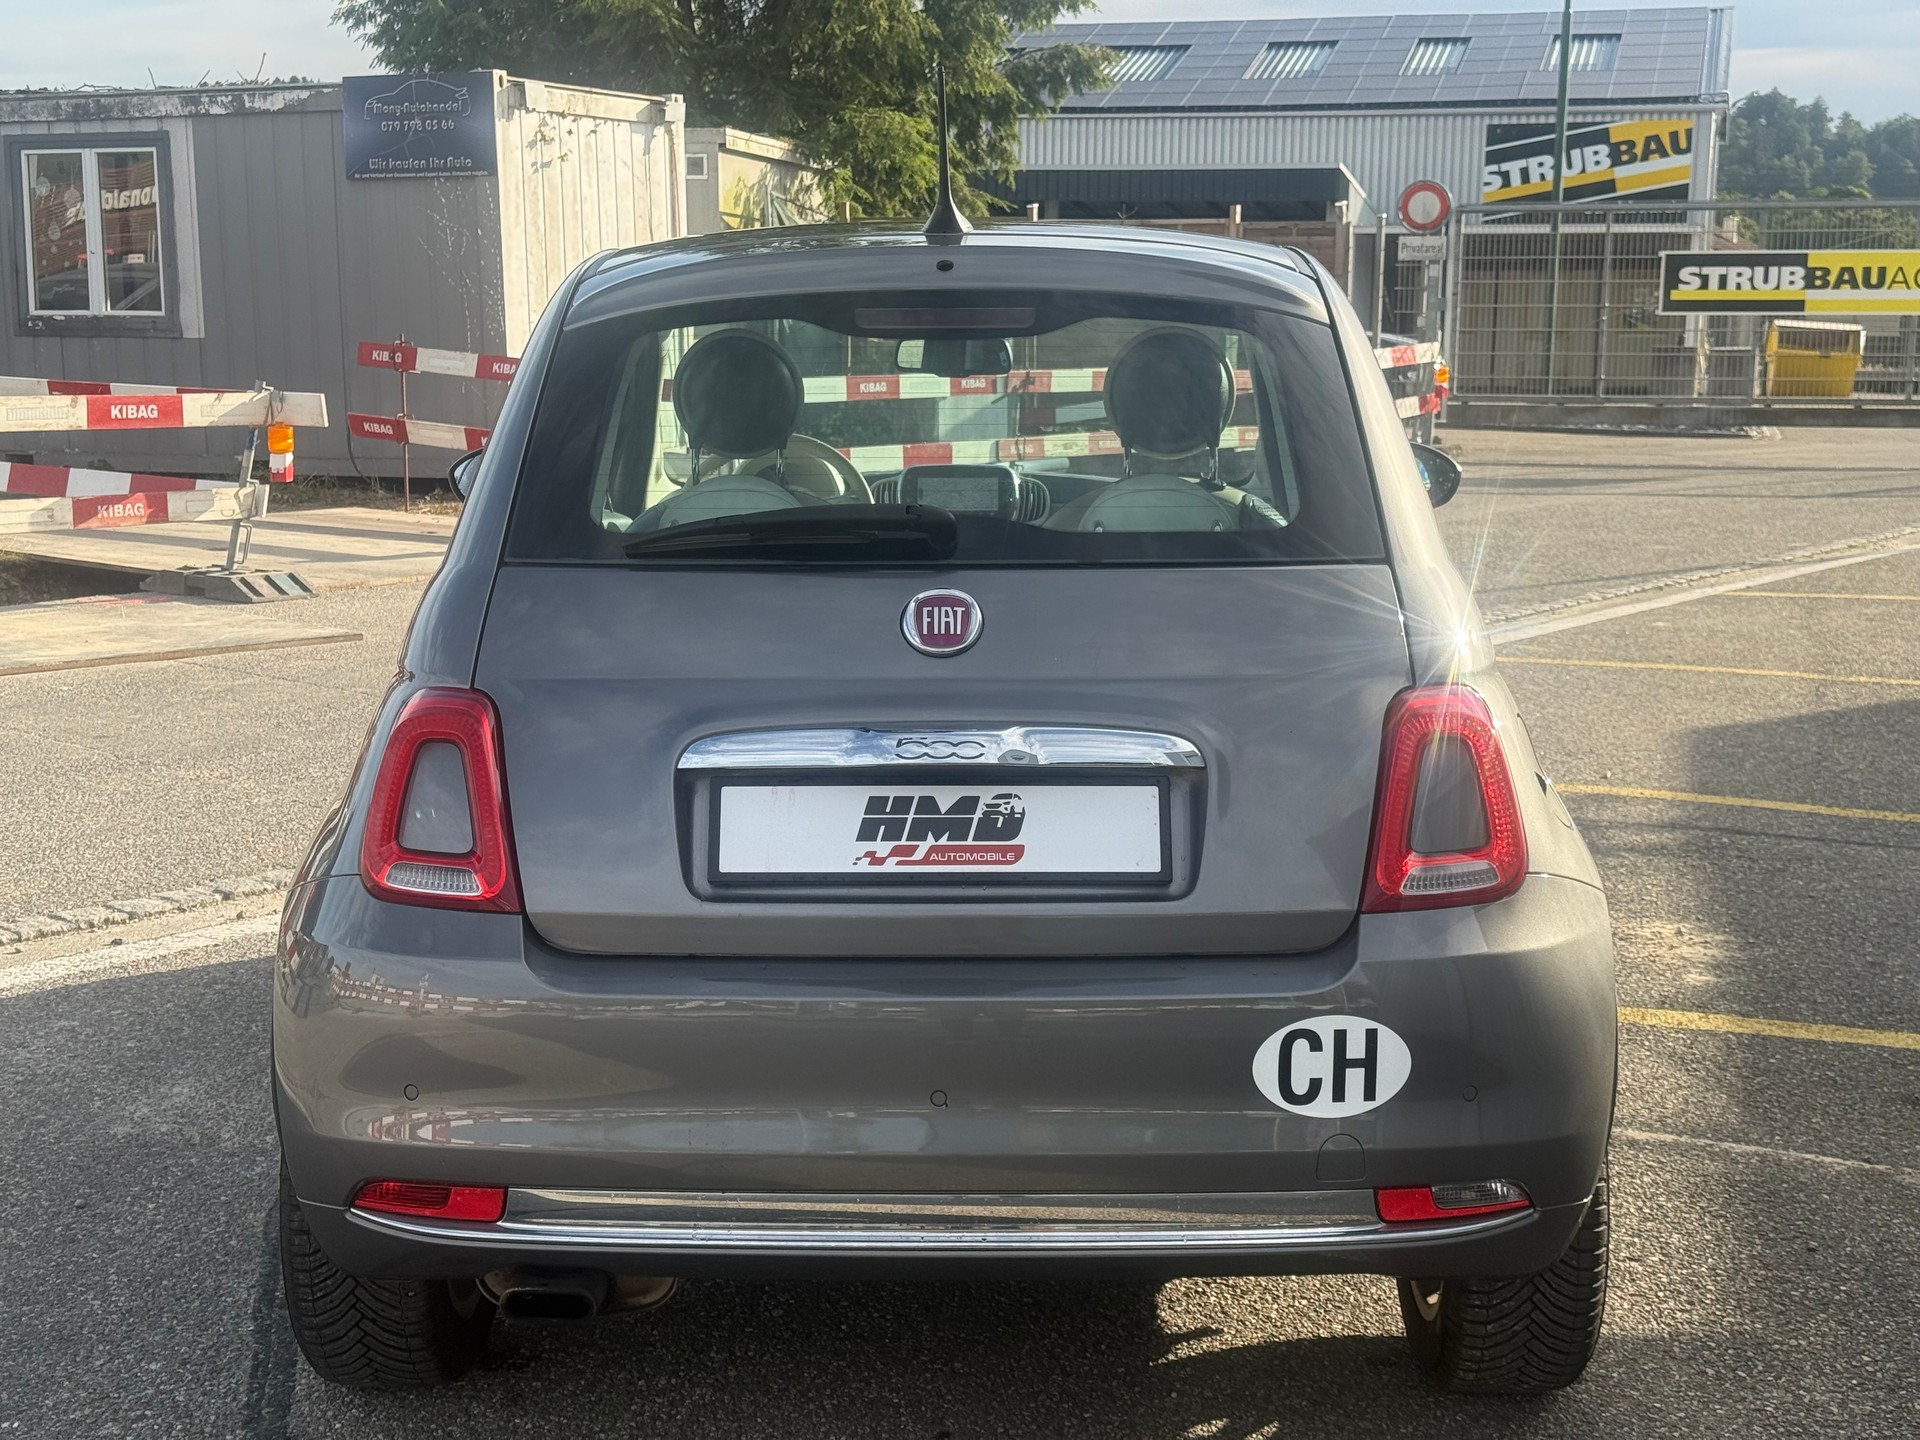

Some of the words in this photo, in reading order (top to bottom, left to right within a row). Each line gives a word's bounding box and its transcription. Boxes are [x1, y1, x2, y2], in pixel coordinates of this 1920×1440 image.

[381, 121, 400, 132] 079
[403, 120, 422, 131] 798
[425, 120, 438, 130] 05
[442, 119, 455, 130] 66
[369, 158, 386, 169] Wir
[389, 157, 427, 169] kaufen
[430, 156, 444, 168] Ihr
[447, 156, 472, 168] Auto
[492, 362, 517, 375] KIBA
[860, 381, 887, 393] KIBAG
[961, 378, 986, 389] KIBAG
[110, 403, 158, 419] KIBAG
[363, 422, 394, 435] KIBAG
[97, 503, 144, 519] KIBAG
[922, 606, 966, 635] FIAT
[894, 737, 987, 760] 500
[855, 794, 1027, 843] HMD
[929, 852, 1016, 862] AUTOMOBILE
[1277, 1027, 1378, 1107] CH
